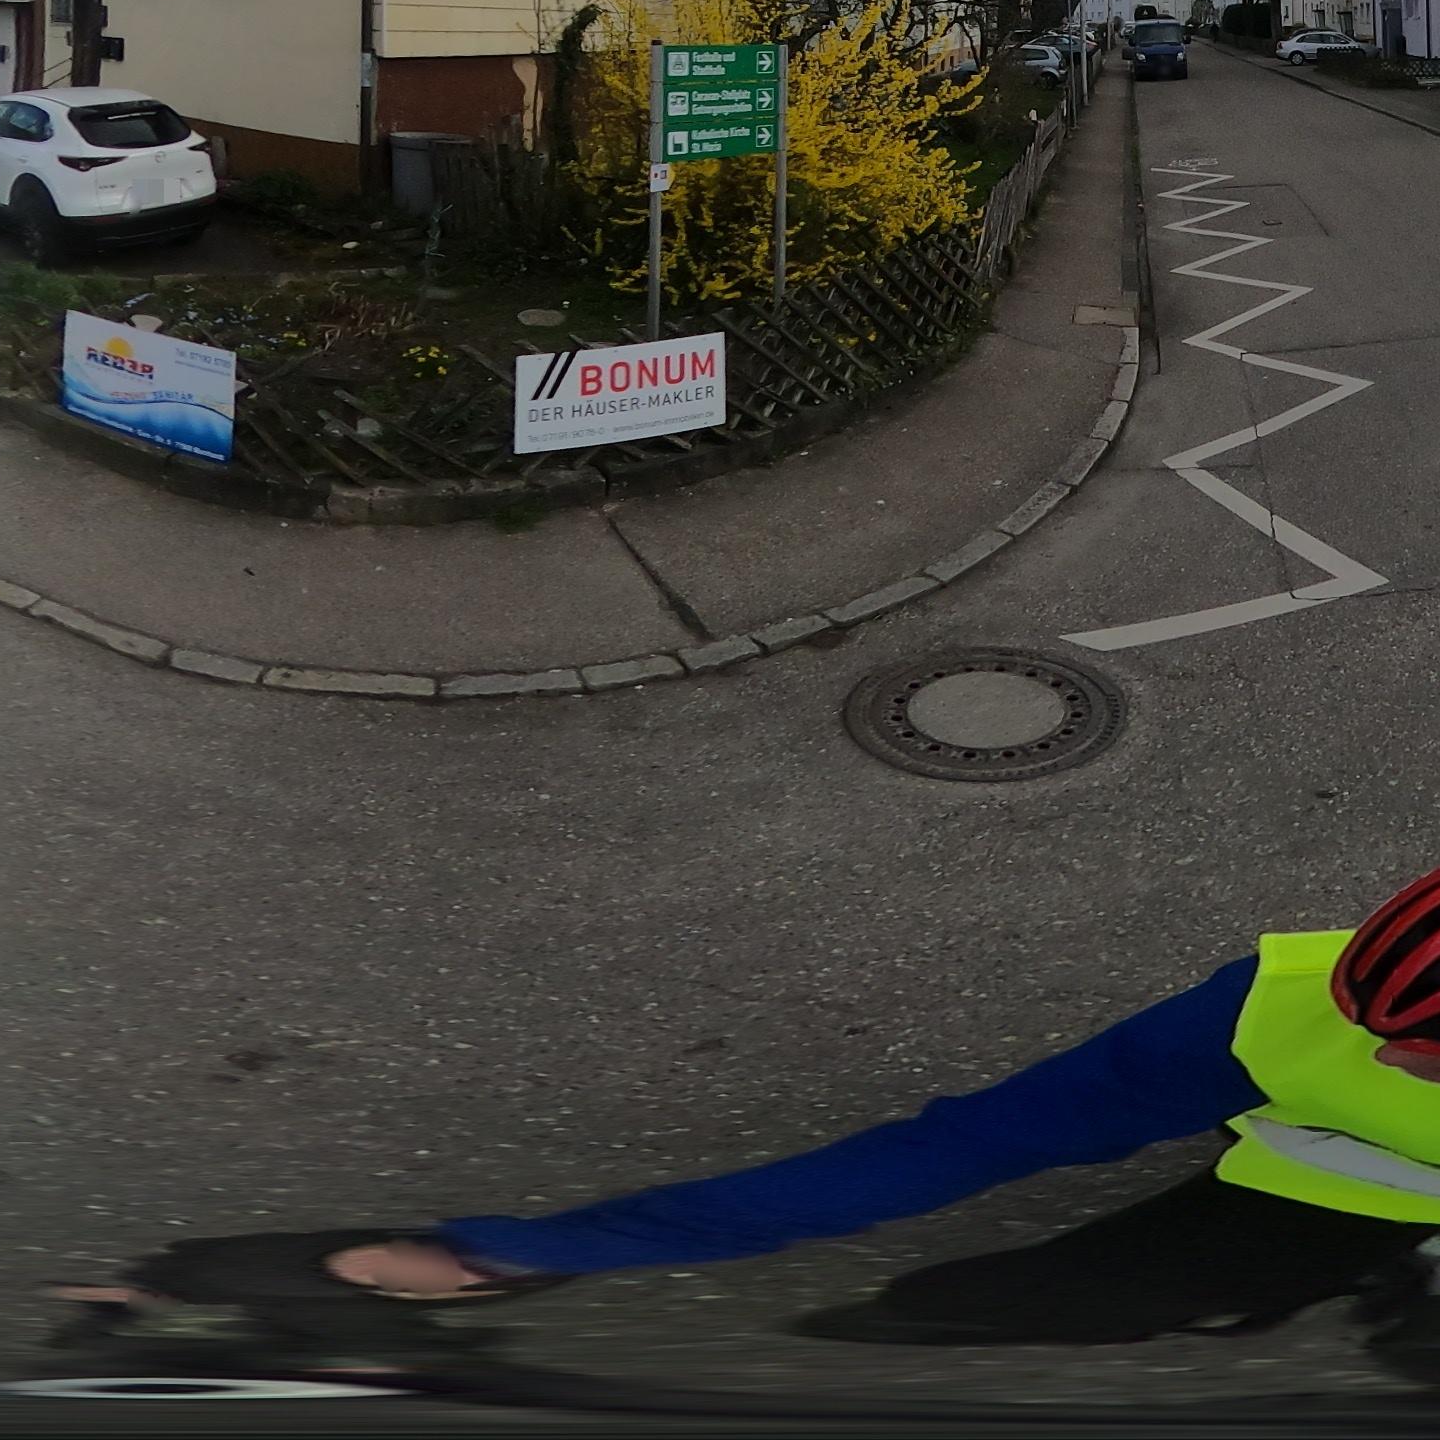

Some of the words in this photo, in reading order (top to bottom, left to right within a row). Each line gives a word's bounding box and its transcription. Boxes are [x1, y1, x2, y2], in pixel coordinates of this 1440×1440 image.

[580, 348, 715, 397] BONUM
[527, 406, 564, 423] DER
[571, 385, 715, 419] HÄUSER-MAKLER
